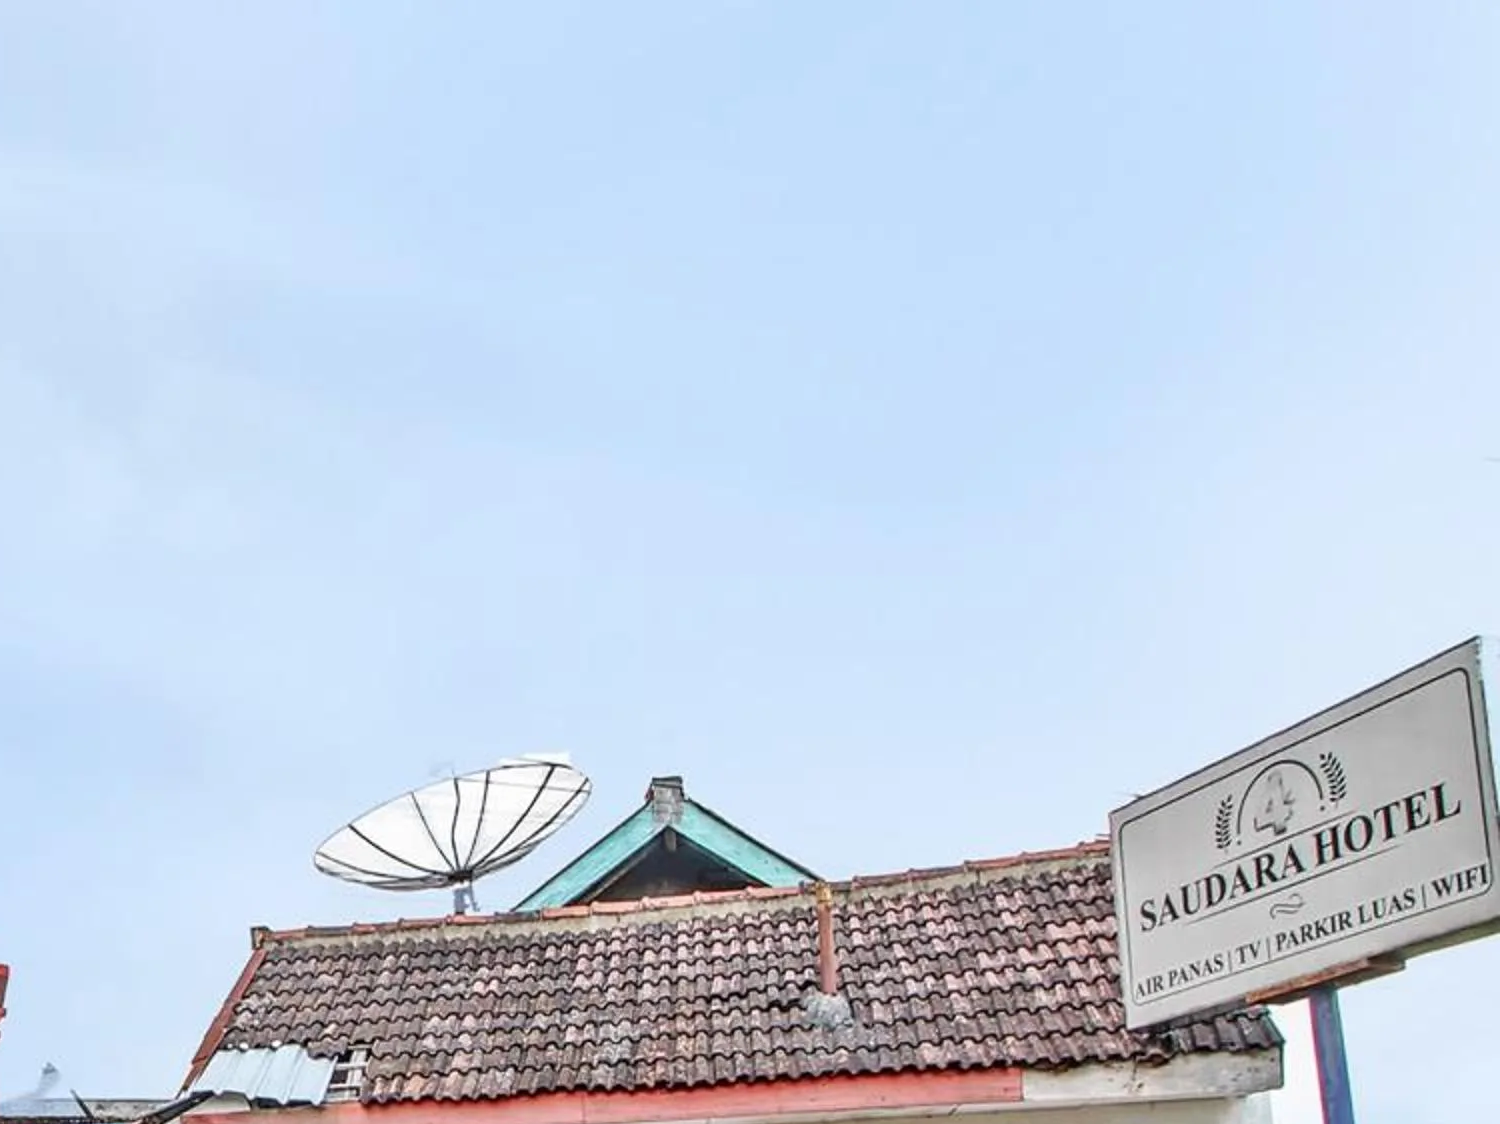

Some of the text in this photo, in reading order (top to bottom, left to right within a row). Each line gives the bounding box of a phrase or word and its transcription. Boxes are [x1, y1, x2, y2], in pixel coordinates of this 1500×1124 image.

[1139, 782, 1463, 933] SAUDARA HOTEL
[1135, 975, 1165, 1001] AIR
[1168, 953, 1225, 987] PANAS
[1235, 942, 1262, 966] TV
[1276, 913, 1354, 953] PARKIR
[1357, 889, 1417, 926] LUAS
[1431, 863, 1490, 900] WIFI
